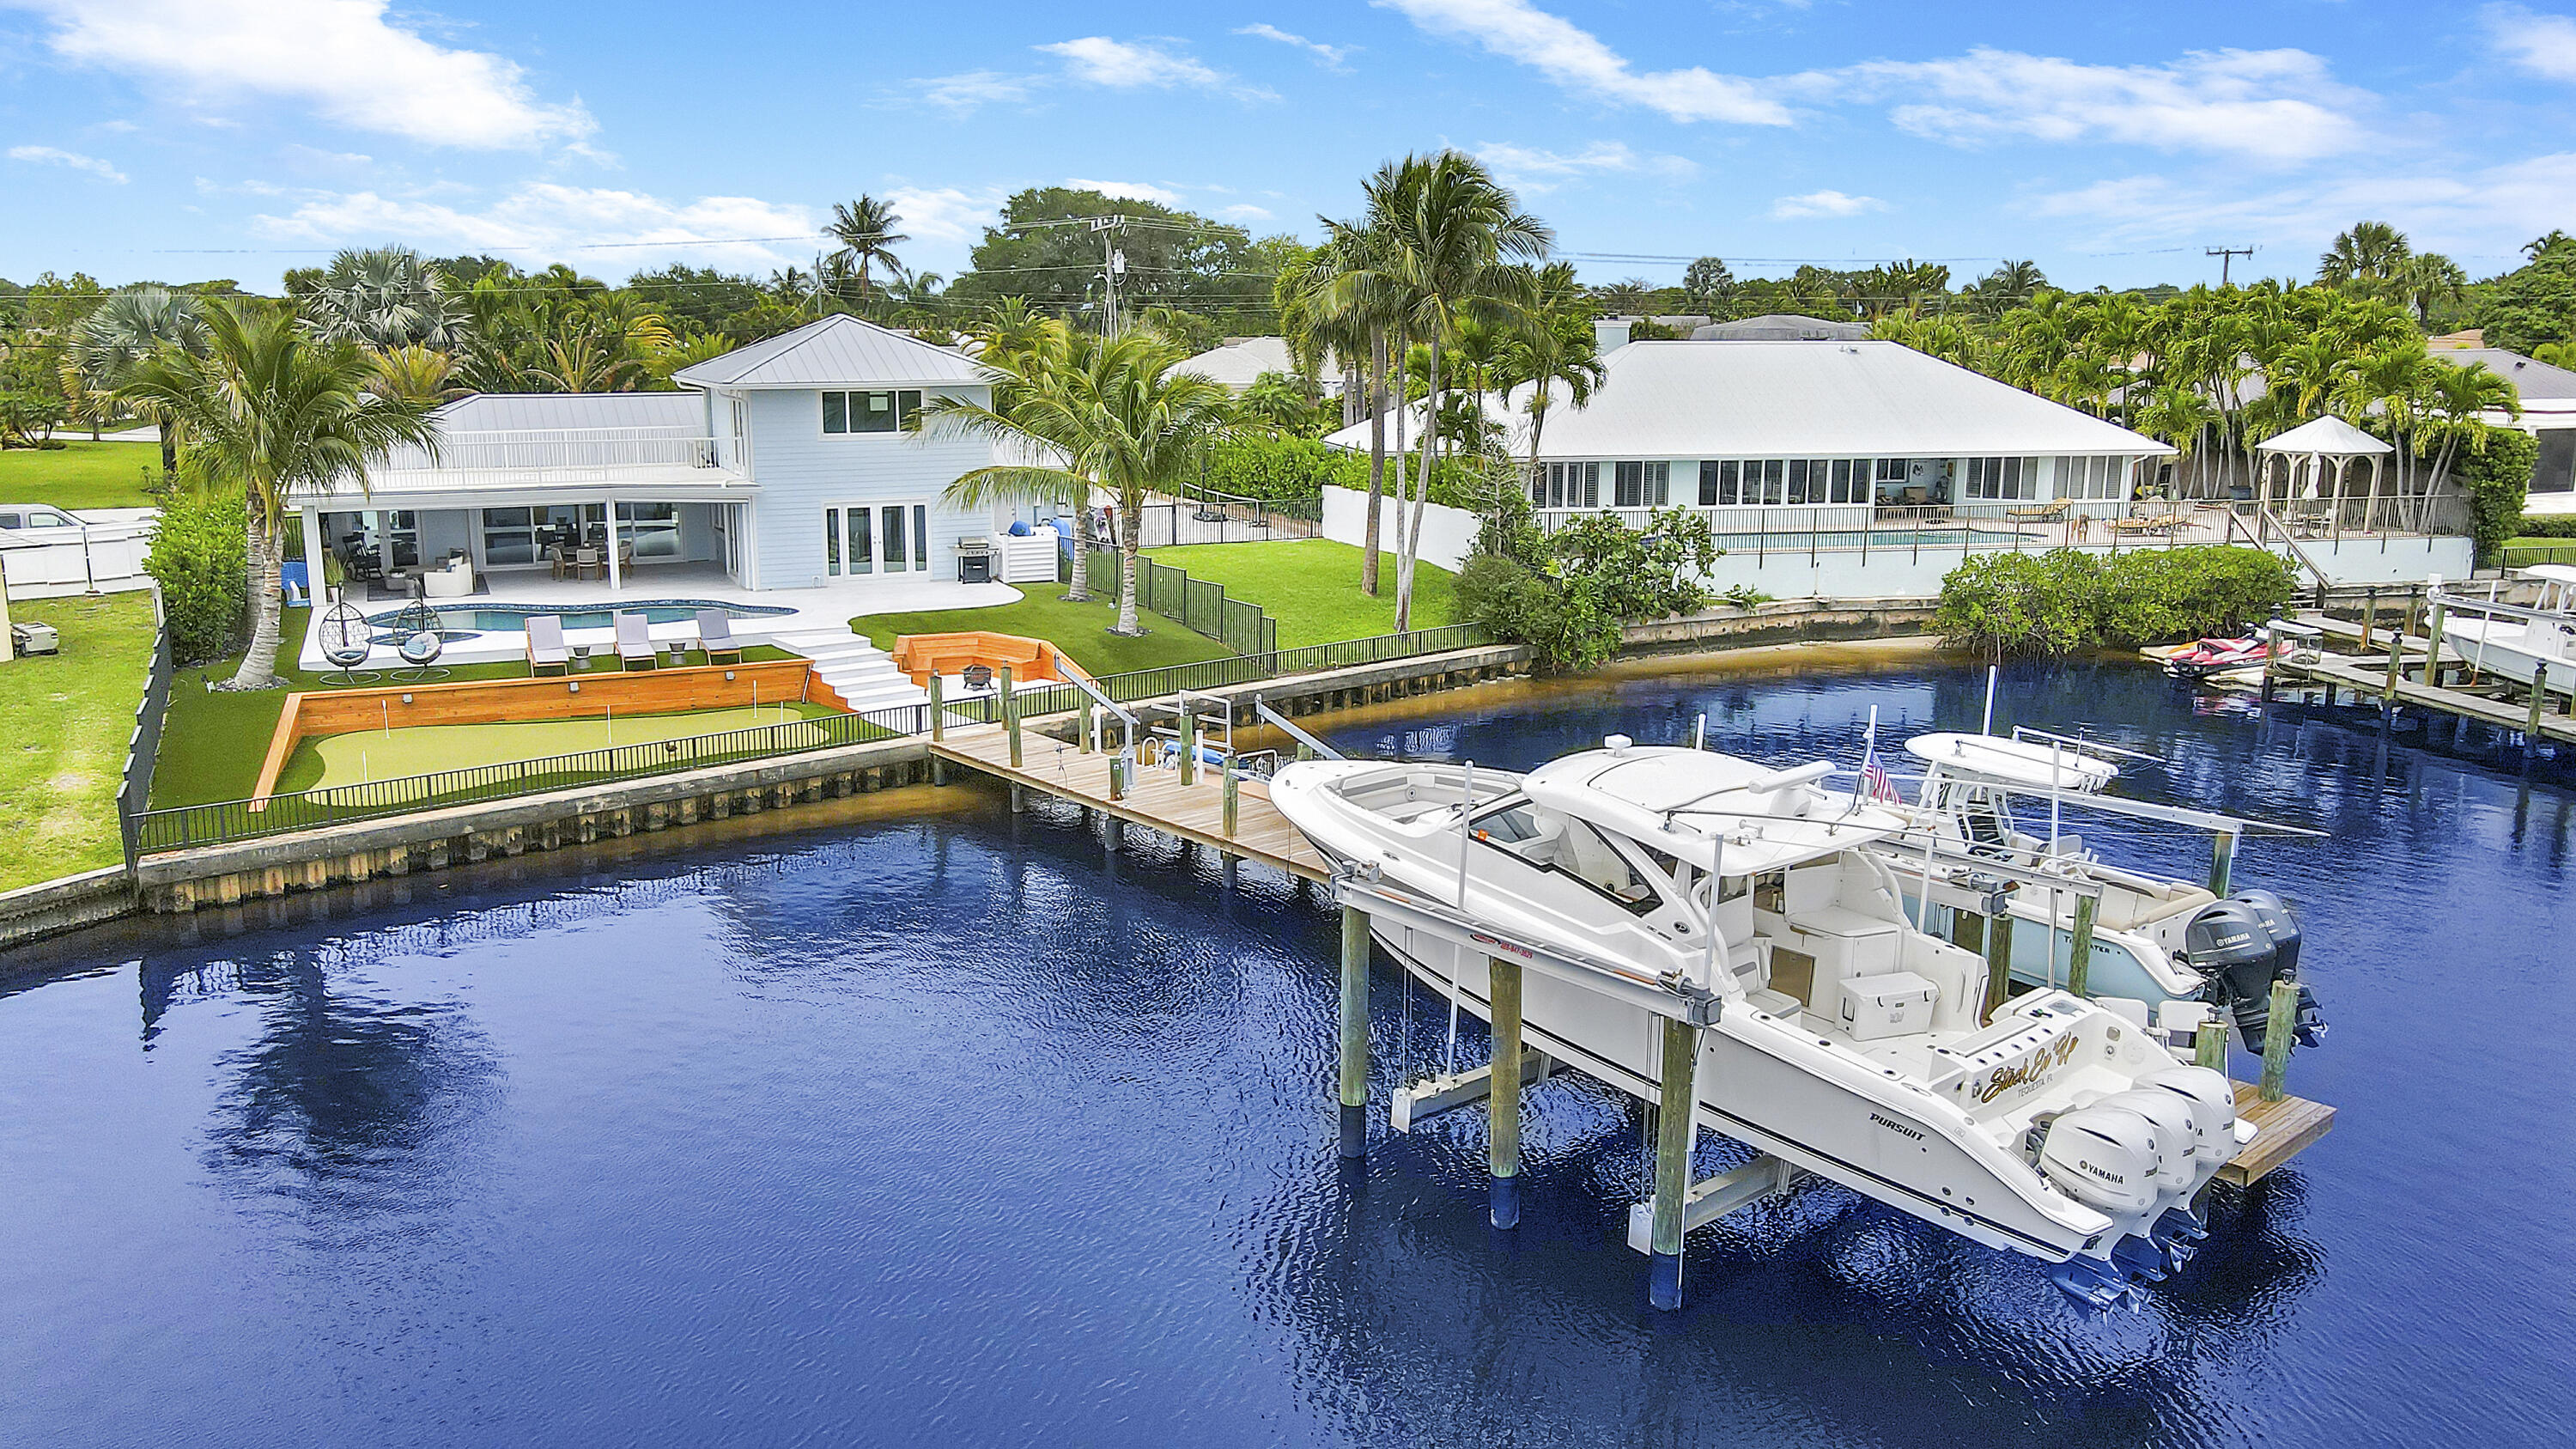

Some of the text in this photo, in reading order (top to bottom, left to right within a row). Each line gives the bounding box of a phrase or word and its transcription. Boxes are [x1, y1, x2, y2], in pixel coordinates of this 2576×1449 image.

[2224, 933, 2251, 945] YAMAHA
[1869, 1112, 1926, 1141] PURSUIT
[2089, 1164, 2123, 1184] YAMAHA
